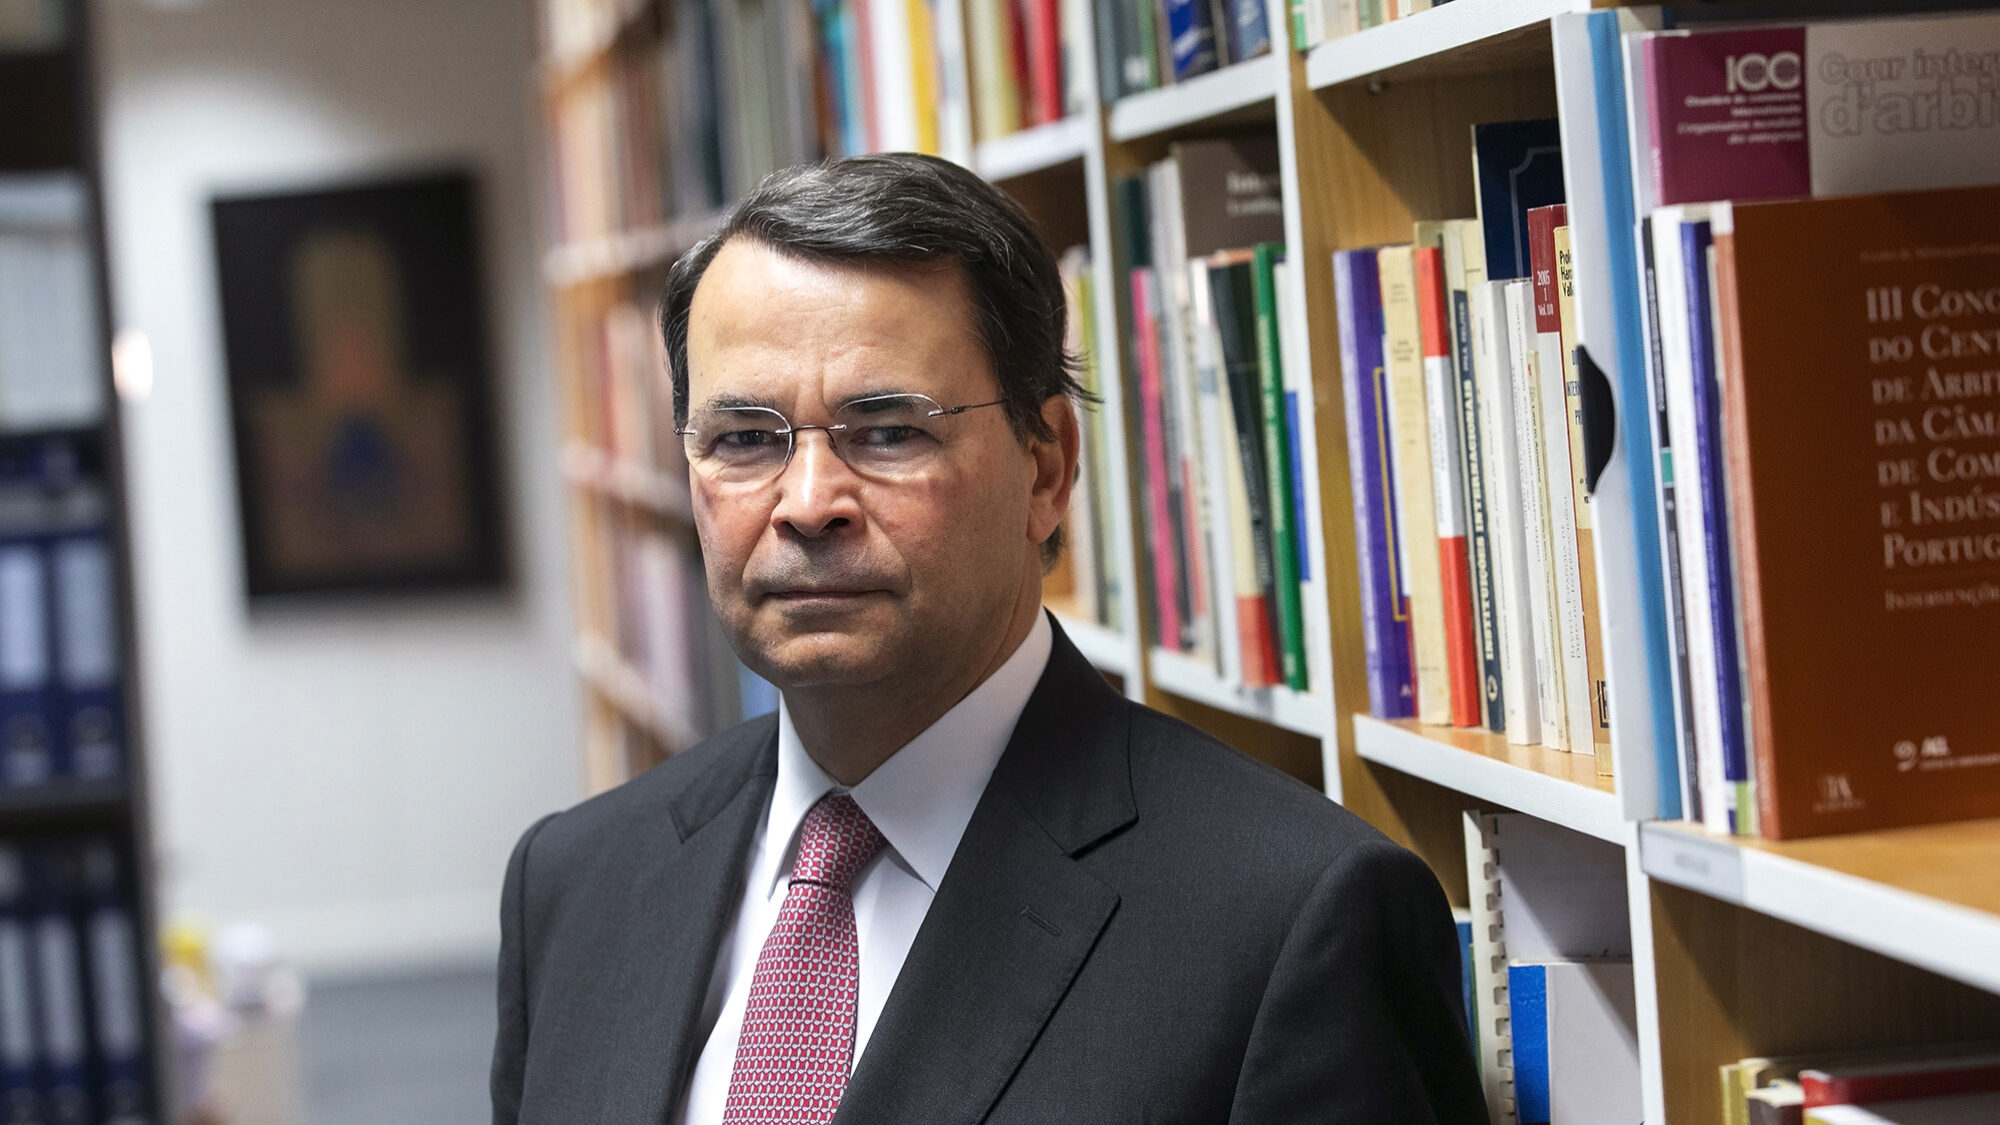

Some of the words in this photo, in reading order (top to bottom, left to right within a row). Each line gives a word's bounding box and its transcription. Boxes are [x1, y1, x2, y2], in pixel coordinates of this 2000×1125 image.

[1725, 51, 1800, 92] ICC
[1818, 52, 1906, 85] Cour
[1537, 270, 1550, 286] 2005
[1866, 285, 1903, 323] III
[1868, 337, 1914, 364] DO
[1871, 376, 1914, 404] DE
[1875, 418, 1916, 446] DA
[1462, 379, 1483, 532] INTERNACIONAIS
[1878, 459, 1920, 487] DE
[1880, 500, 1901, 528] E
[1475, 536, 1494, 660] INSTITUIÇÕES
